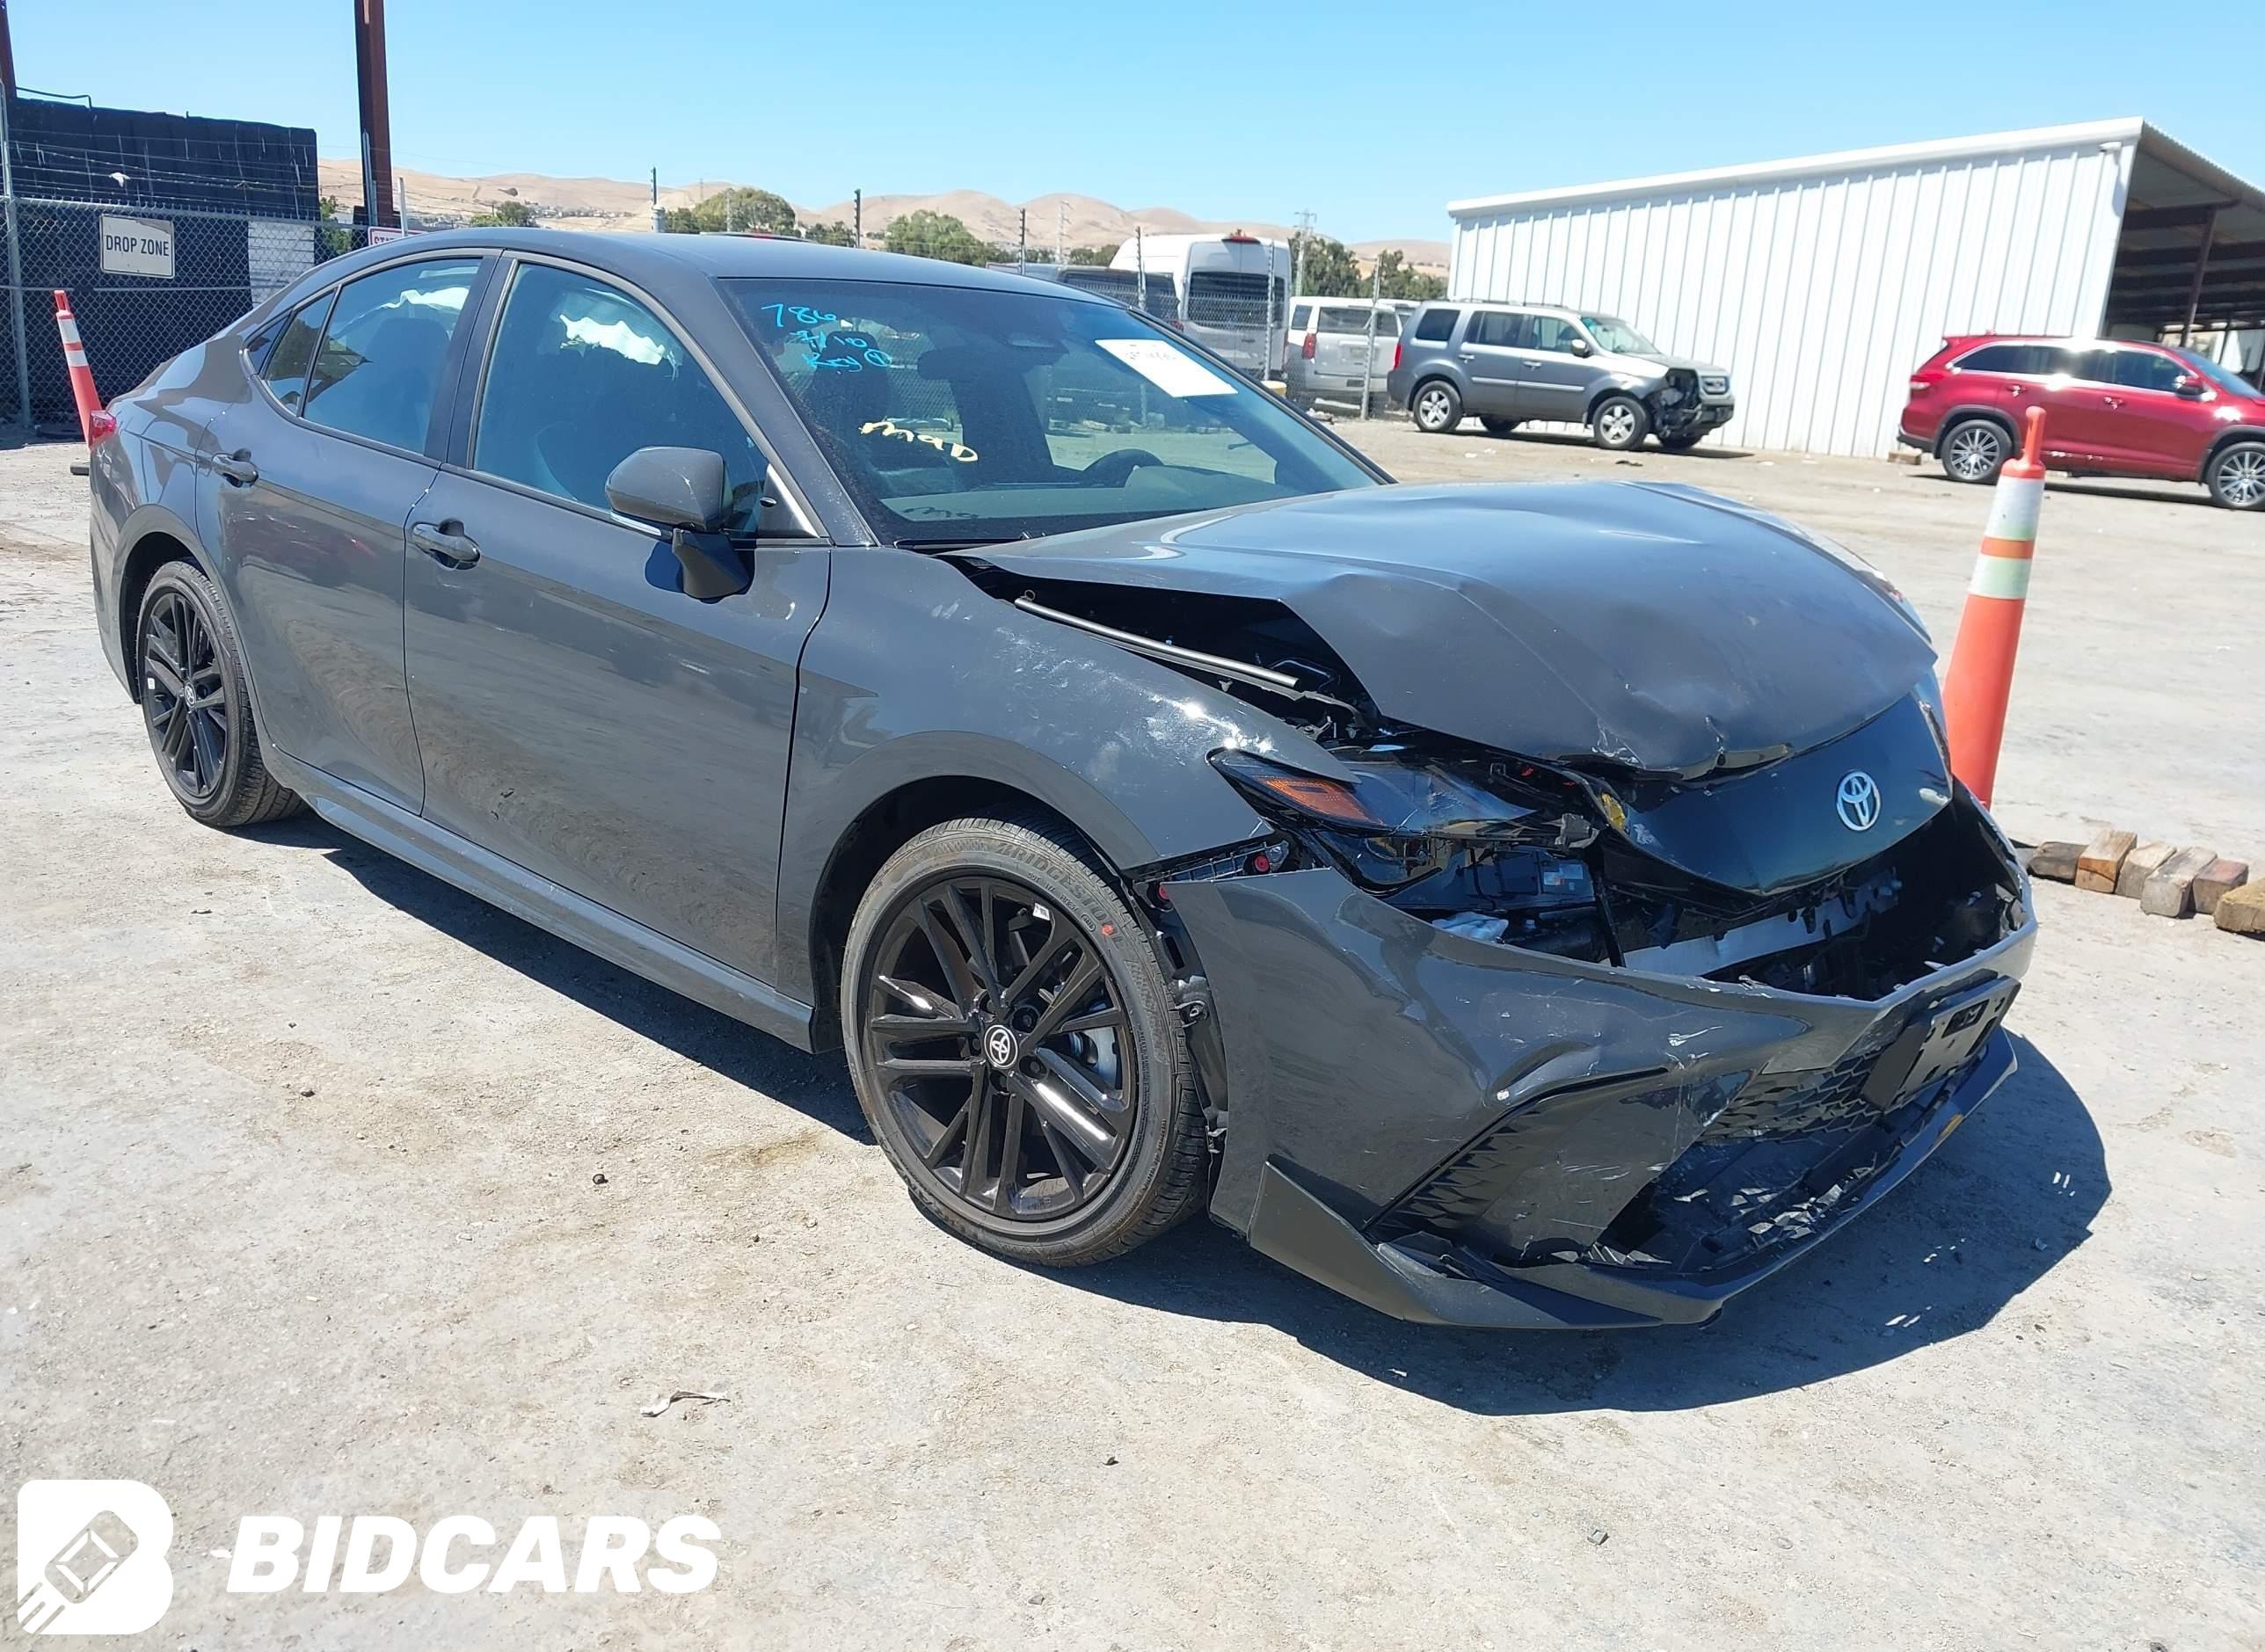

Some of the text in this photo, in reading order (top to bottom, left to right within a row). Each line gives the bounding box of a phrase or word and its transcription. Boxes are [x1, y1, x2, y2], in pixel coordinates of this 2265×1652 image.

[106, 235, 170, 257] DROP ZONE
[761, 303, 837, 328] 786
